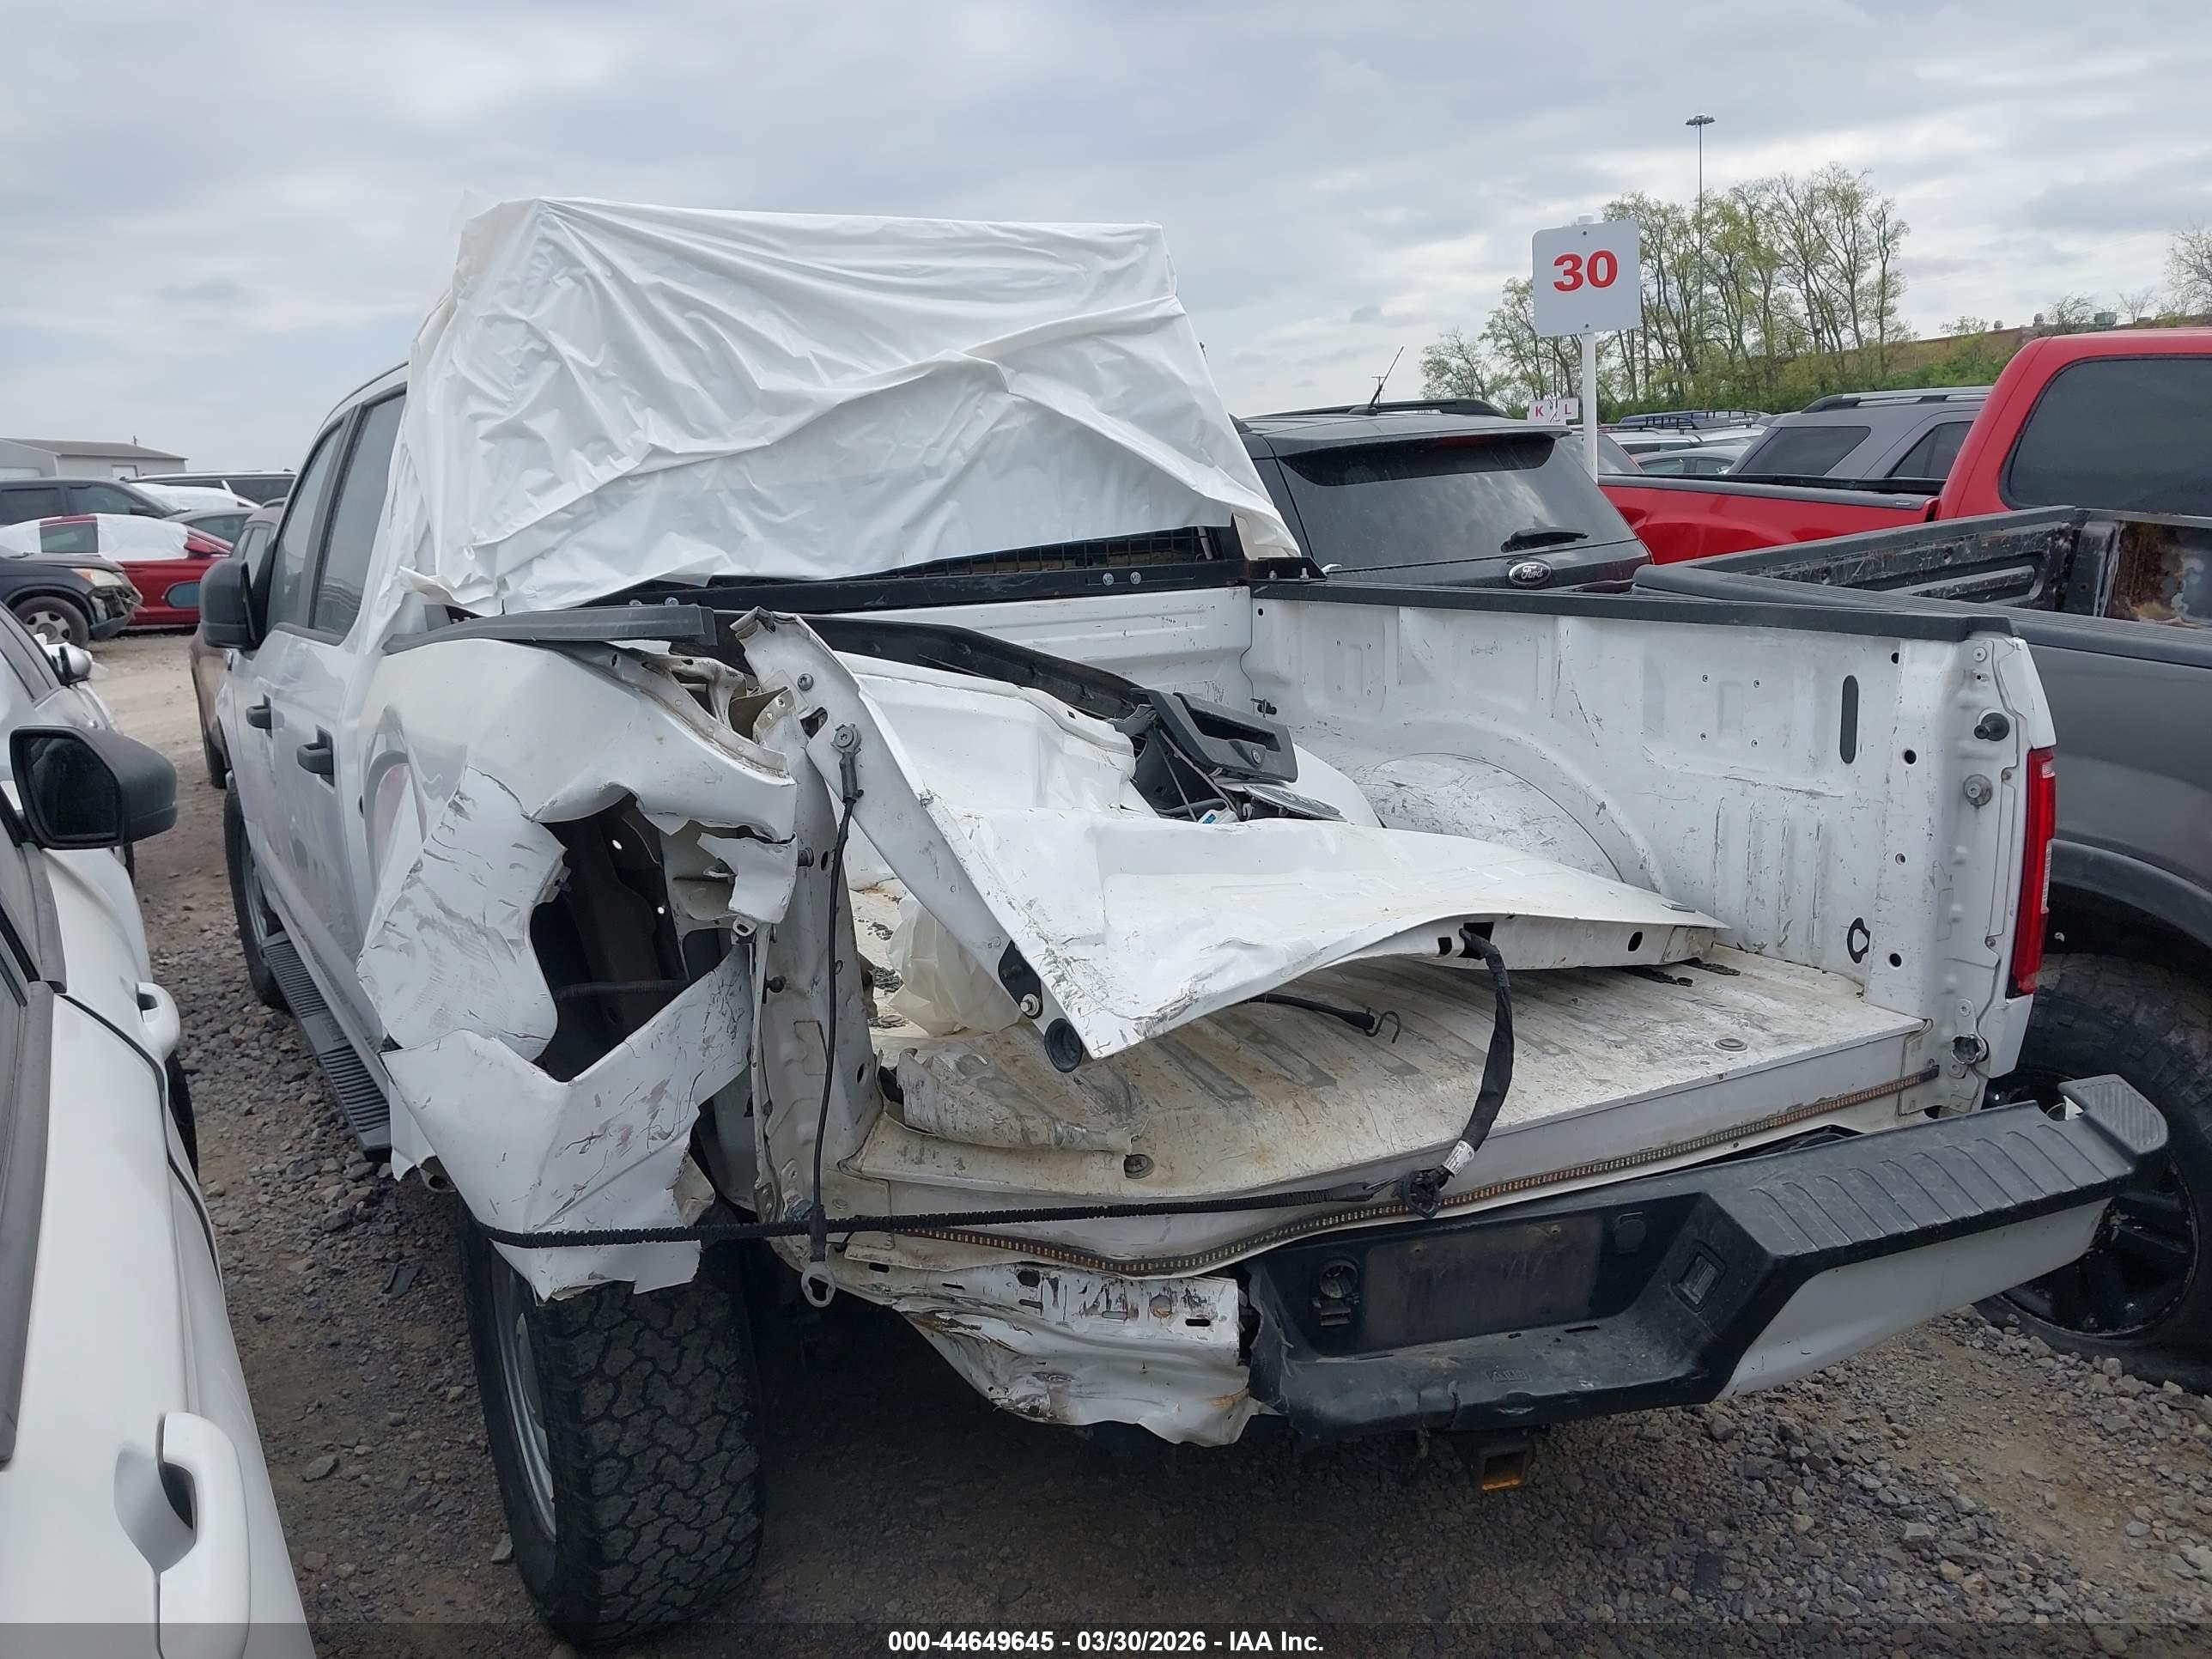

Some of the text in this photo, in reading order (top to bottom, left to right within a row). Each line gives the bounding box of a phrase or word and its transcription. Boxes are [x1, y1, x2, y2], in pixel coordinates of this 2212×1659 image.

[1553, 249, 1619, 294] 30
[1535, 405, 1544, 417] K
[1565, 404, 1572, 415] L
[1521, 565, 1544, 580] Ford
